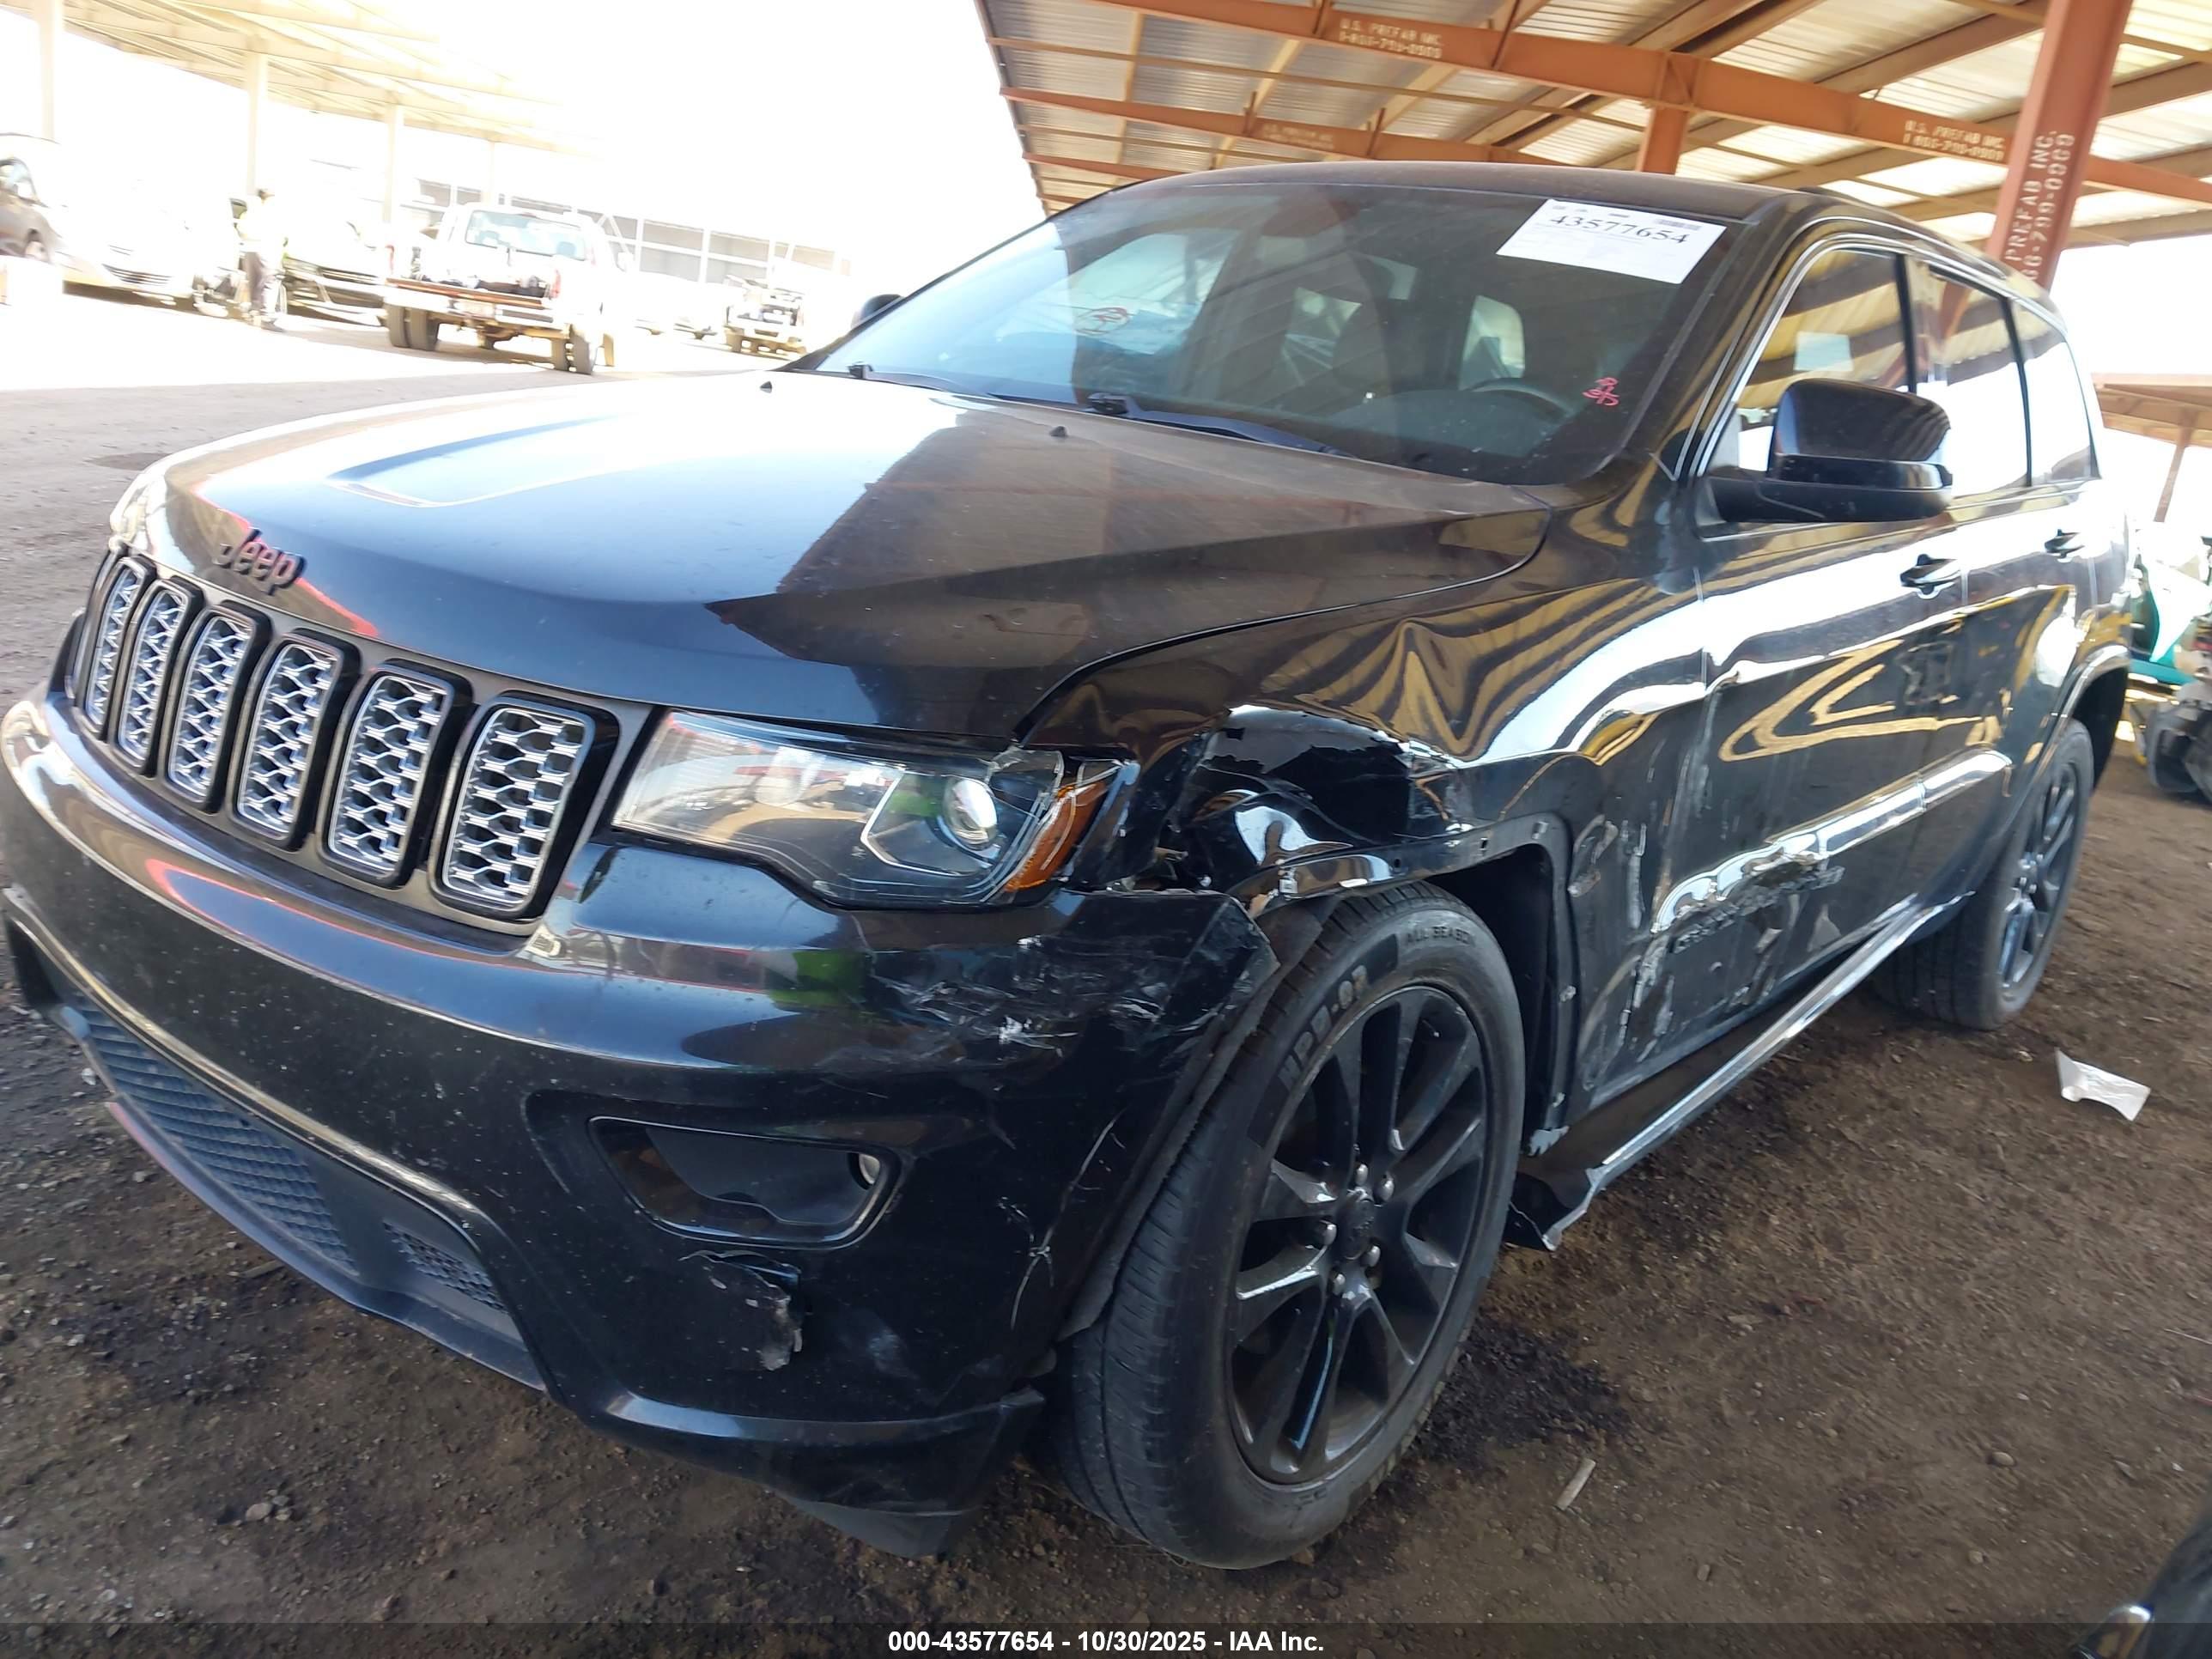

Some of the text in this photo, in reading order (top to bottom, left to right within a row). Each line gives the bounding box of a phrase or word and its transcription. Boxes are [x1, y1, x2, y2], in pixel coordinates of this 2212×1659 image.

[1549, 215, 1690, 244] 43577654
[2005, 179, 2043, 262] PREFAB
[212, 526, 307, 595] Jeep
